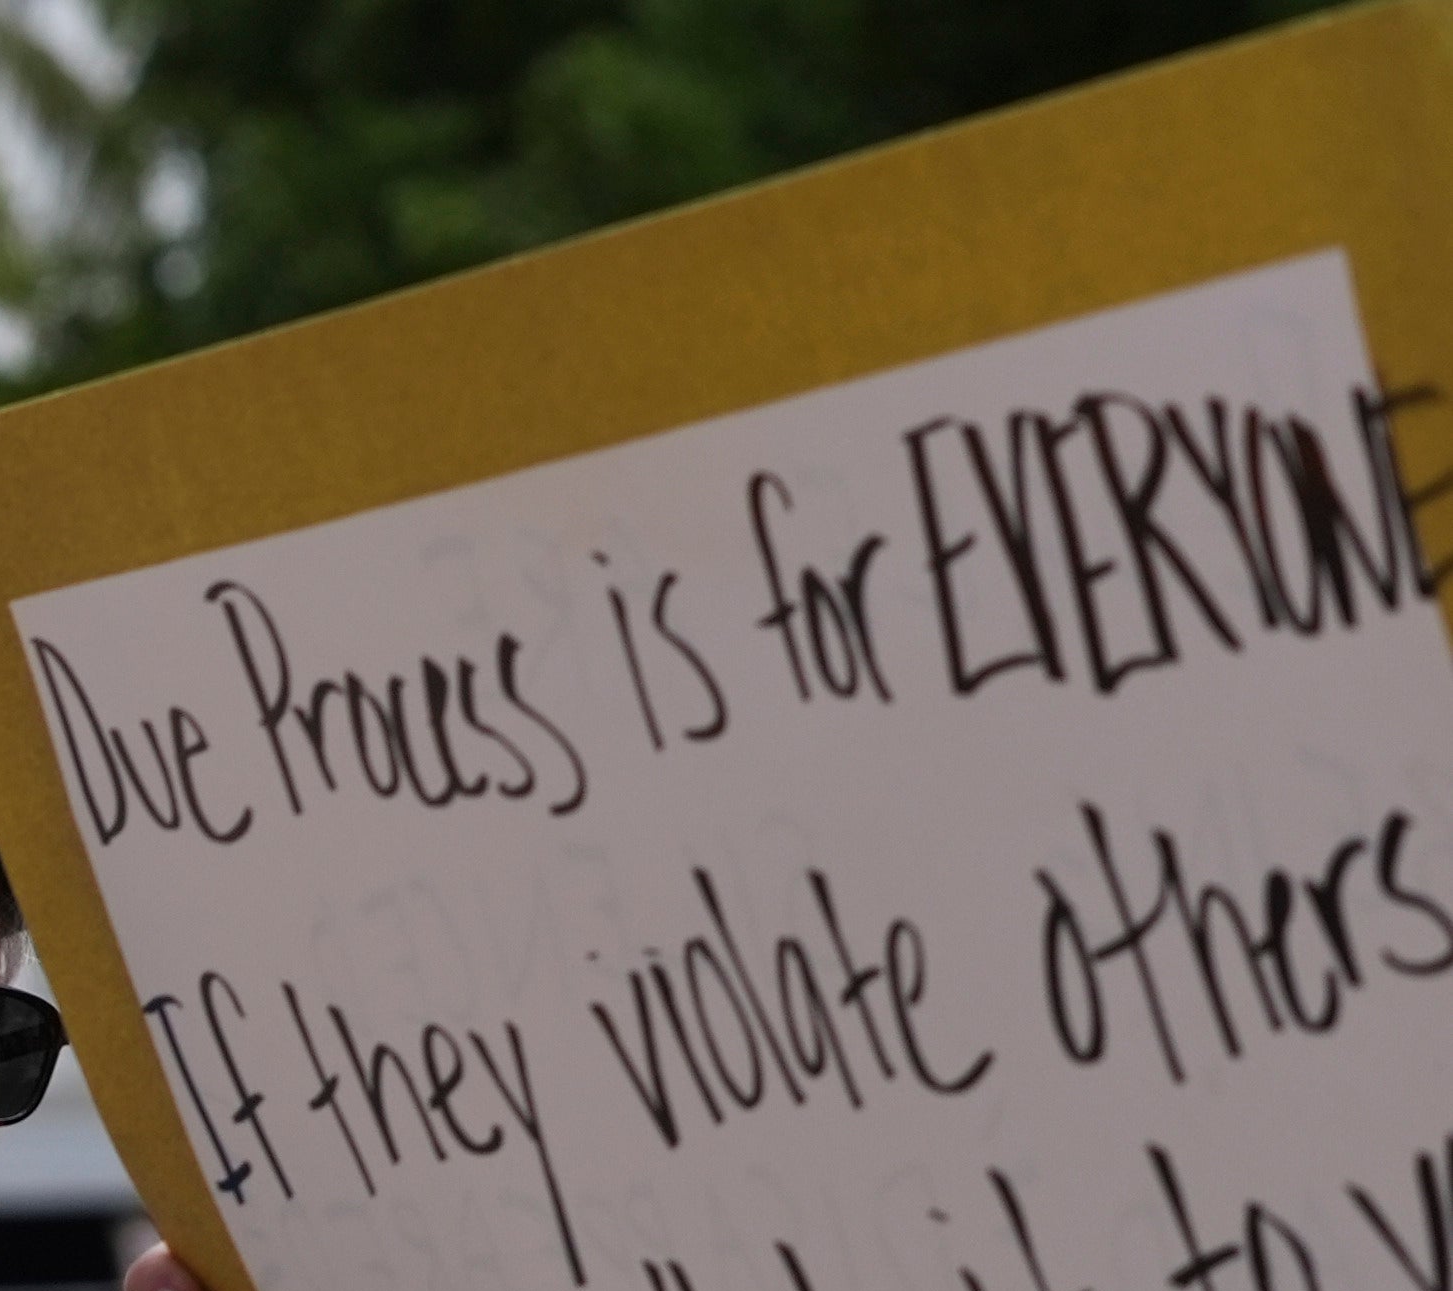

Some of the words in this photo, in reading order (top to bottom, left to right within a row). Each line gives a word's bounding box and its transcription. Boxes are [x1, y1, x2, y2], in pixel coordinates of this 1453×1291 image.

[31, 636, 253, 846] Due
[204, 580, 587, 816] Process
[591, 551, 728, 753] is
[748, 469, 894, 705] for
[143, 970, 295, 1206] If
[281, 981, 586, 1288] they
[587, 868, 994, 1149] violate
[1034, 800, 1453, 1084] others
